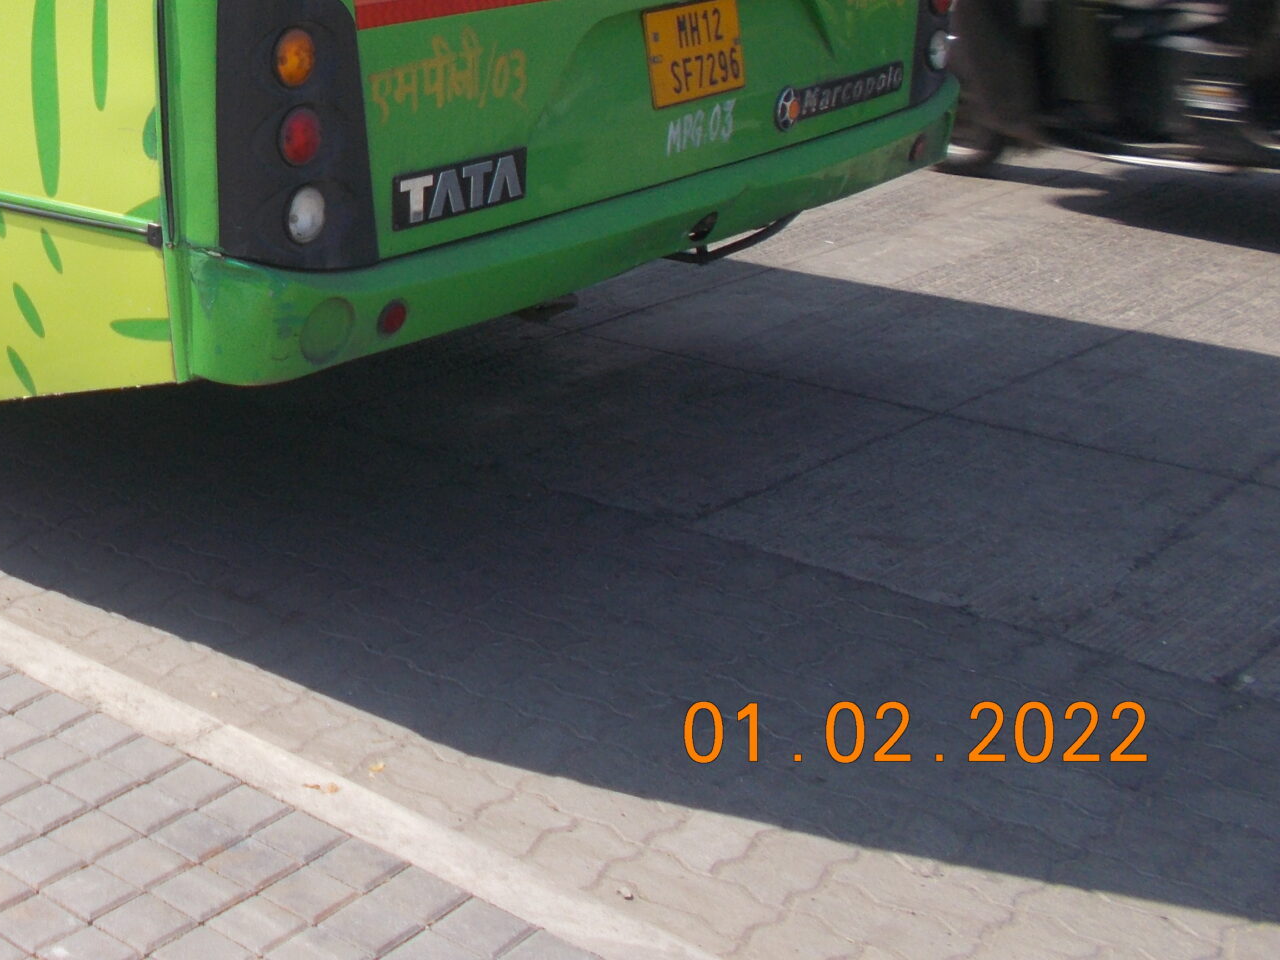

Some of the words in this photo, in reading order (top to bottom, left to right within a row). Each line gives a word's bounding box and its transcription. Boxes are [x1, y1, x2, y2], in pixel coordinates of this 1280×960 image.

[670, 47, 741, 95] SF7296
[801, 65, 903, 115] Marcopolo
[400, 155, 523, 223] TATA
